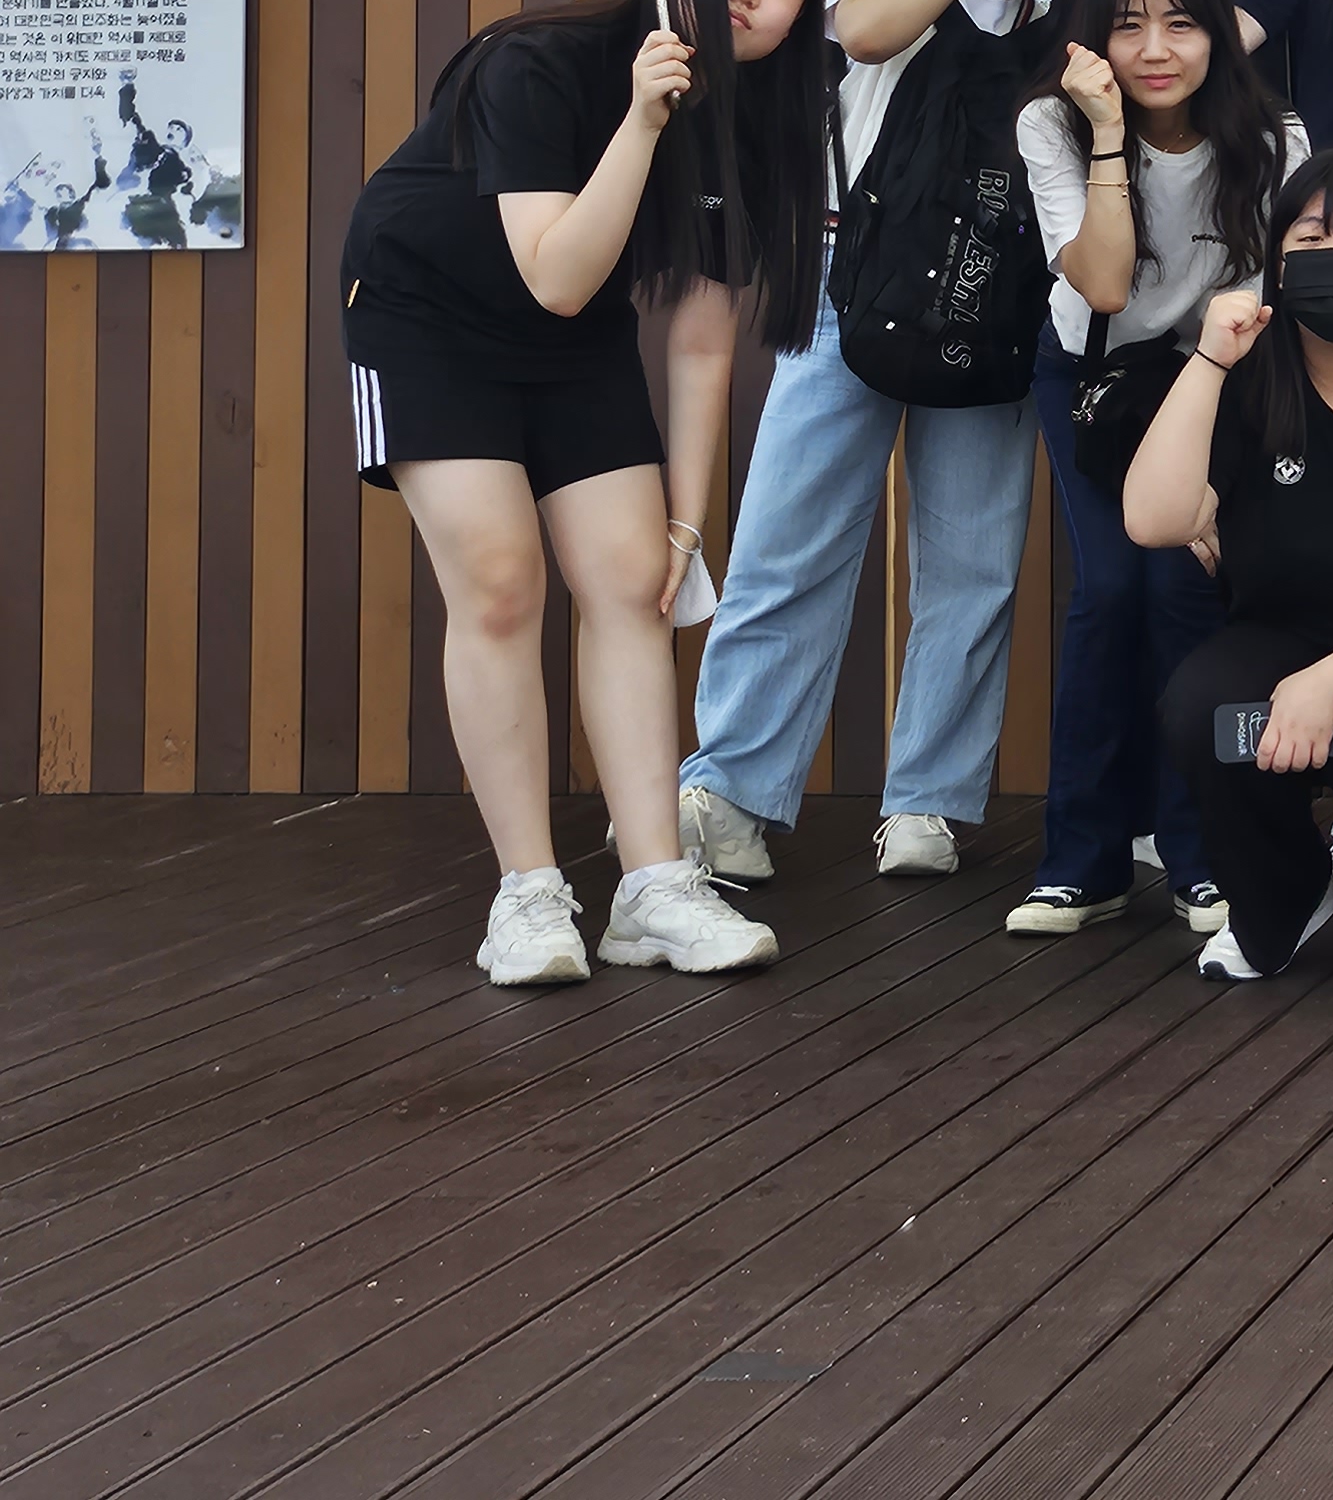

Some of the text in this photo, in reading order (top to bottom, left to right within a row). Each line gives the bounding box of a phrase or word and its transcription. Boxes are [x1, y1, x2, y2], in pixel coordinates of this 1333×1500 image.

[15, 14, 77, 27] 대한민국의
[82, 13, 132, 26] 민주화는
[23, 31, 186, 46] 것은 이 위대한 역사를 제대로
[10, 51, 47, 63] 역사적
[53, 50, 89, 62] 가치도
[2, 69, 65, 82] 창원시민의
[39, 87, 75, 99] 가치를
